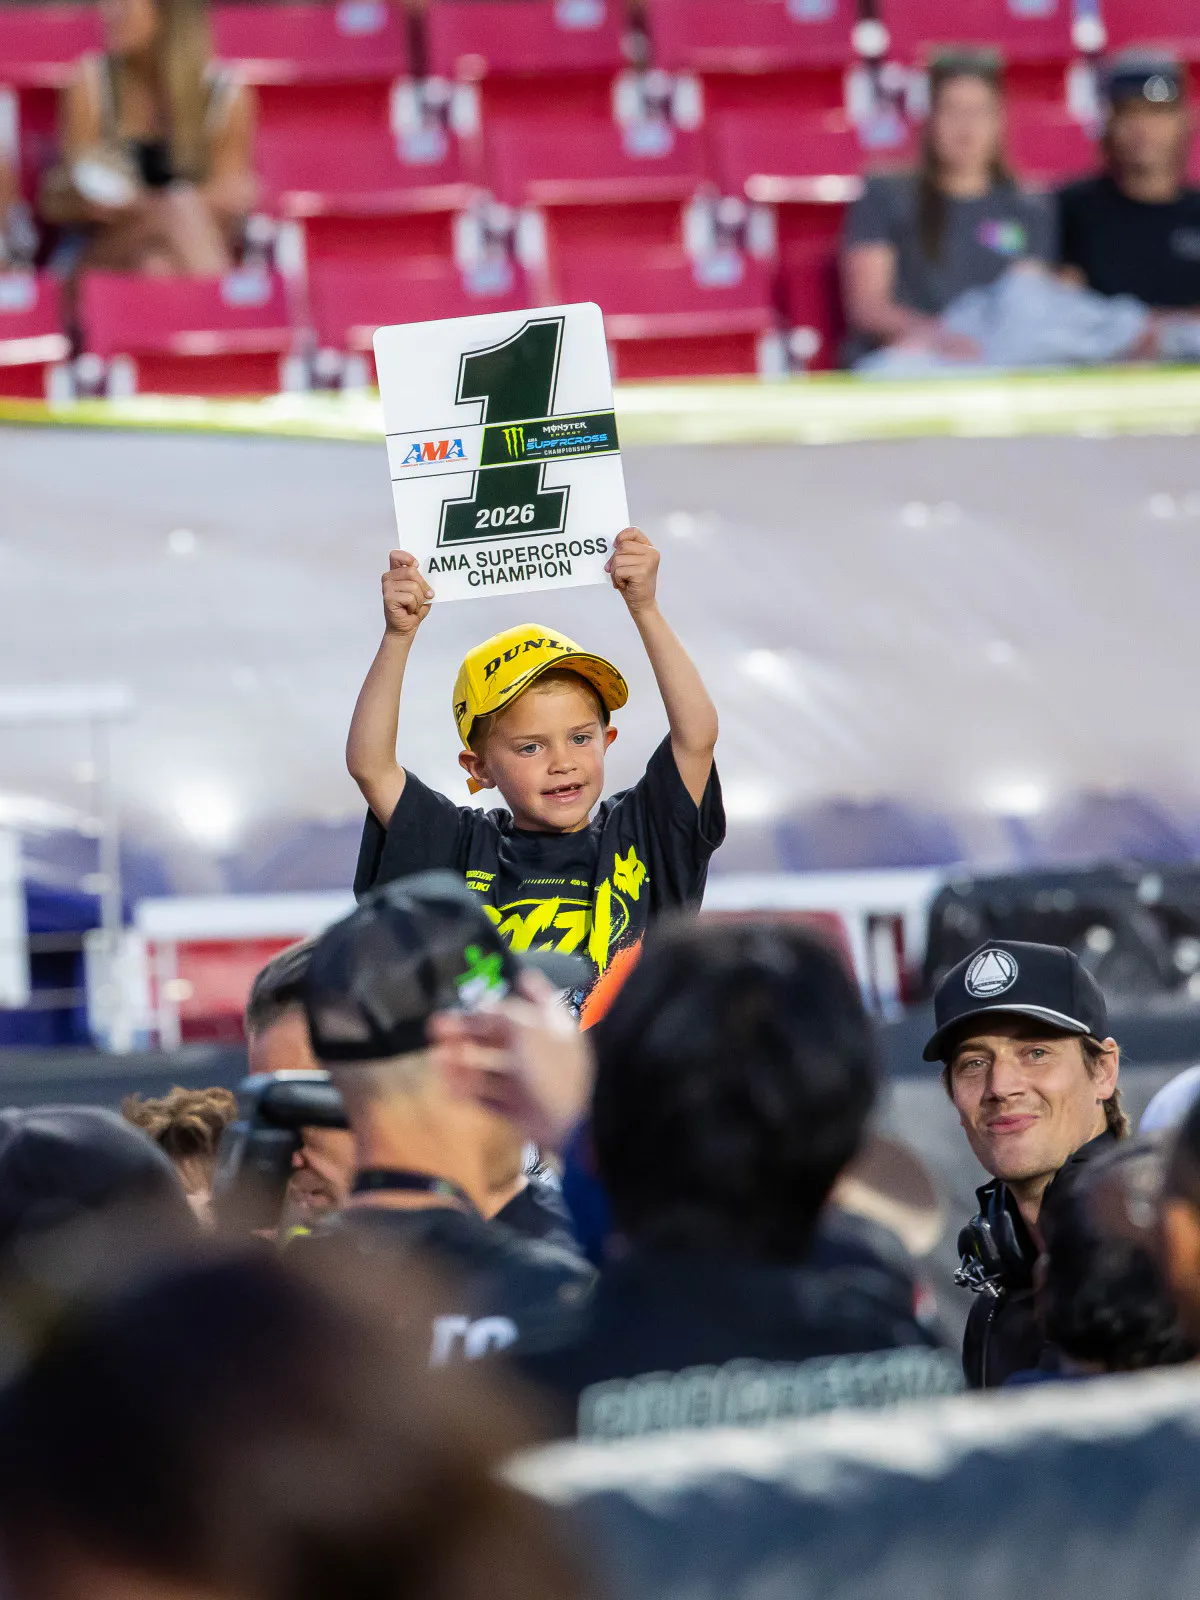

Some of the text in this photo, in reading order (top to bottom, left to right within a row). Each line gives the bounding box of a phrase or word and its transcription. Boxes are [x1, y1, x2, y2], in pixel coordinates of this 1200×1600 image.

[436, 315, 571, 548] 1
[543, 422, 587, 433] MONSTER
[401, 438, 468, 465] AMA
[526, 434, 608, 450] SUPERCROSS
[544, 445, 591, 455] CHAMPIONSHIP
[474, 503, 535, 529] 2026
[428, 537, 608, 574] AMA SUPERCROSS
[467, 559, 573, 587] CHAMPION
